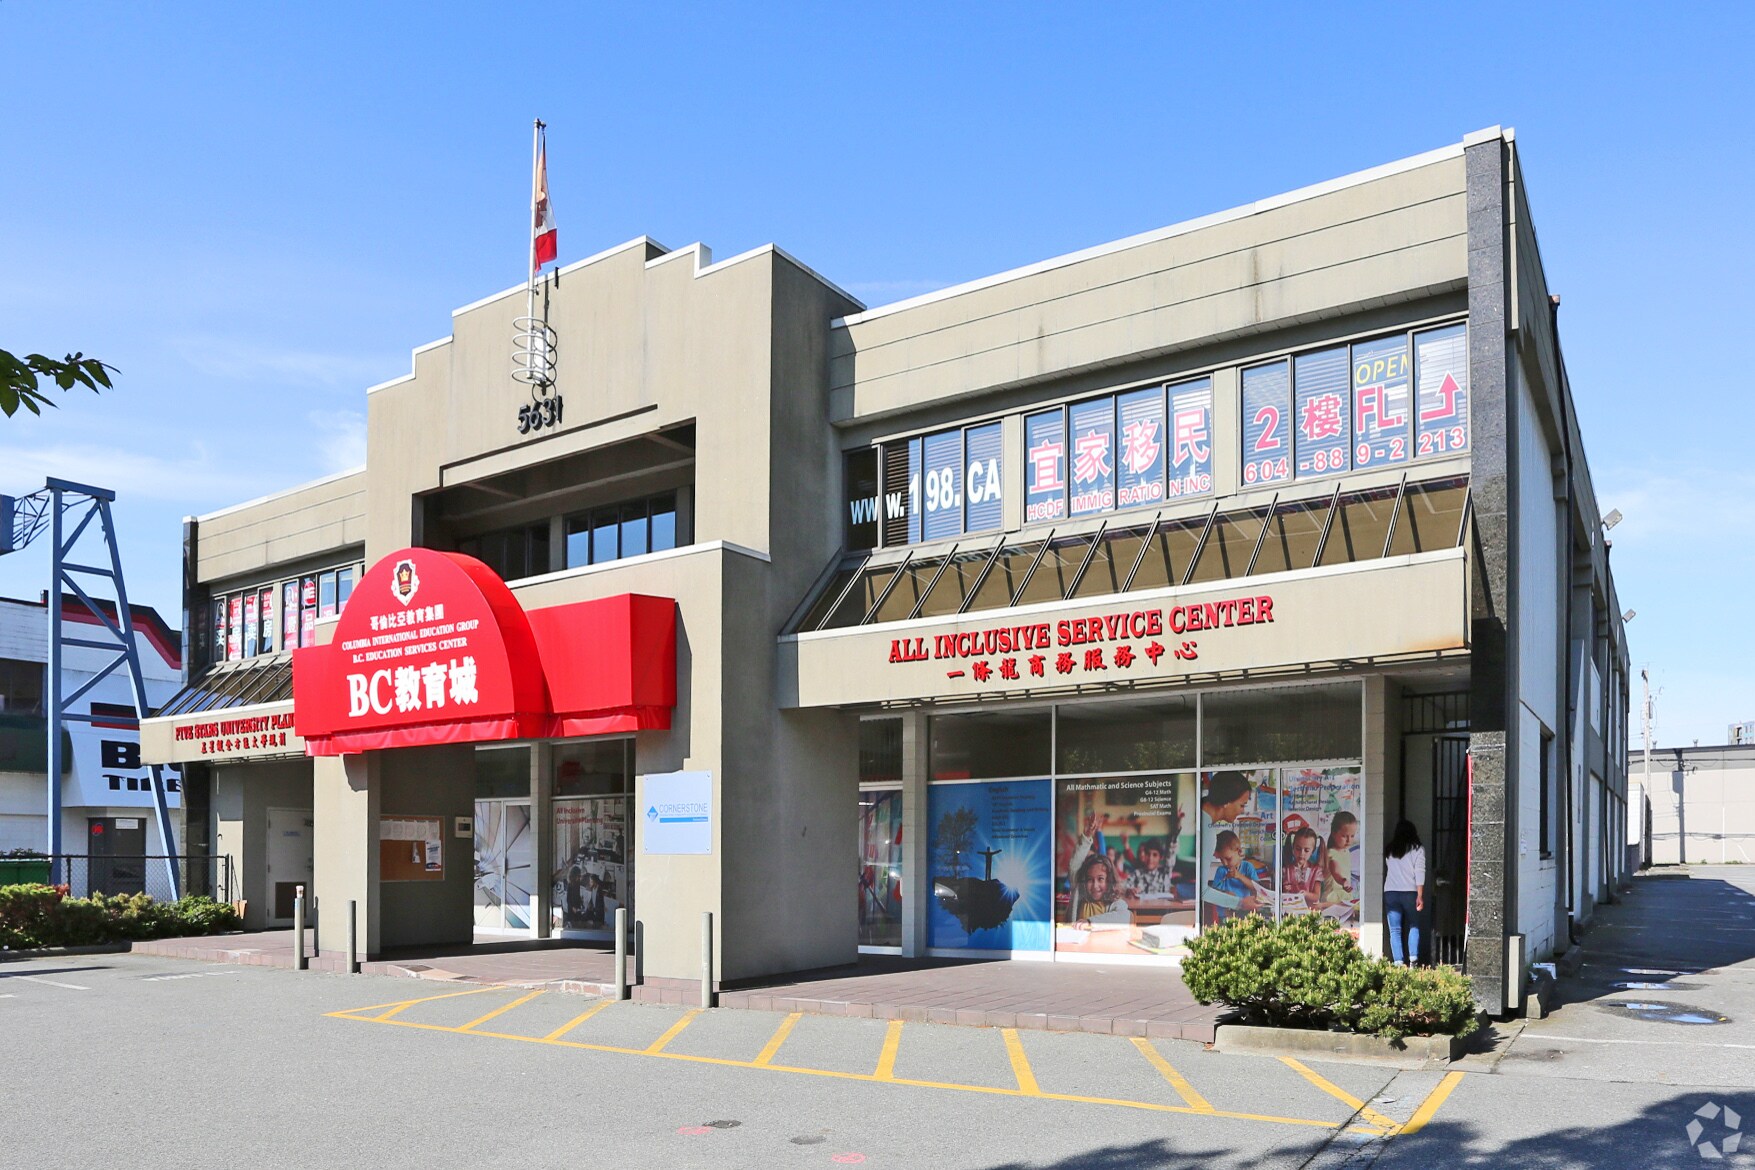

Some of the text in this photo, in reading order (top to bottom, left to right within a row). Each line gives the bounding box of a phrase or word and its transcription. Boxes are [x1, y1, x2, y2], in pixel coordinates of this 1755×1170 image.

[517, 395, 564, 434] 5631
[1356, 385, 1405, 434] FL.
[1028, 407, 1211, 495] 宜家移民
[1027, 501, 1063, 521] HCDF
[1184, 475, 1211, 493] INC
[342, 619, 479, 651] COLUMBIA INTERNATIONAL EDUCATION GROUP
[889, 595, 1275, 663] ALL INCLUSIVE SERVICE CENTER
[353, 637, 468, 663] B.C. EDUCATION SERVICES CENTER
[947, 641, 1199, 682] 一條龍商務服務中心
[195, 722, 219, 739] STARS
[220, 716, 270, 736] UNIVERSITY
[1108, 782, 1120, 790] and
[1120, 781, 1144, 789] Science
[1145, 780, 1172, 789] Subjects
[659, 802, 708, 813] CORNERSTONE
[1260, 811, 1274, 819] Art
